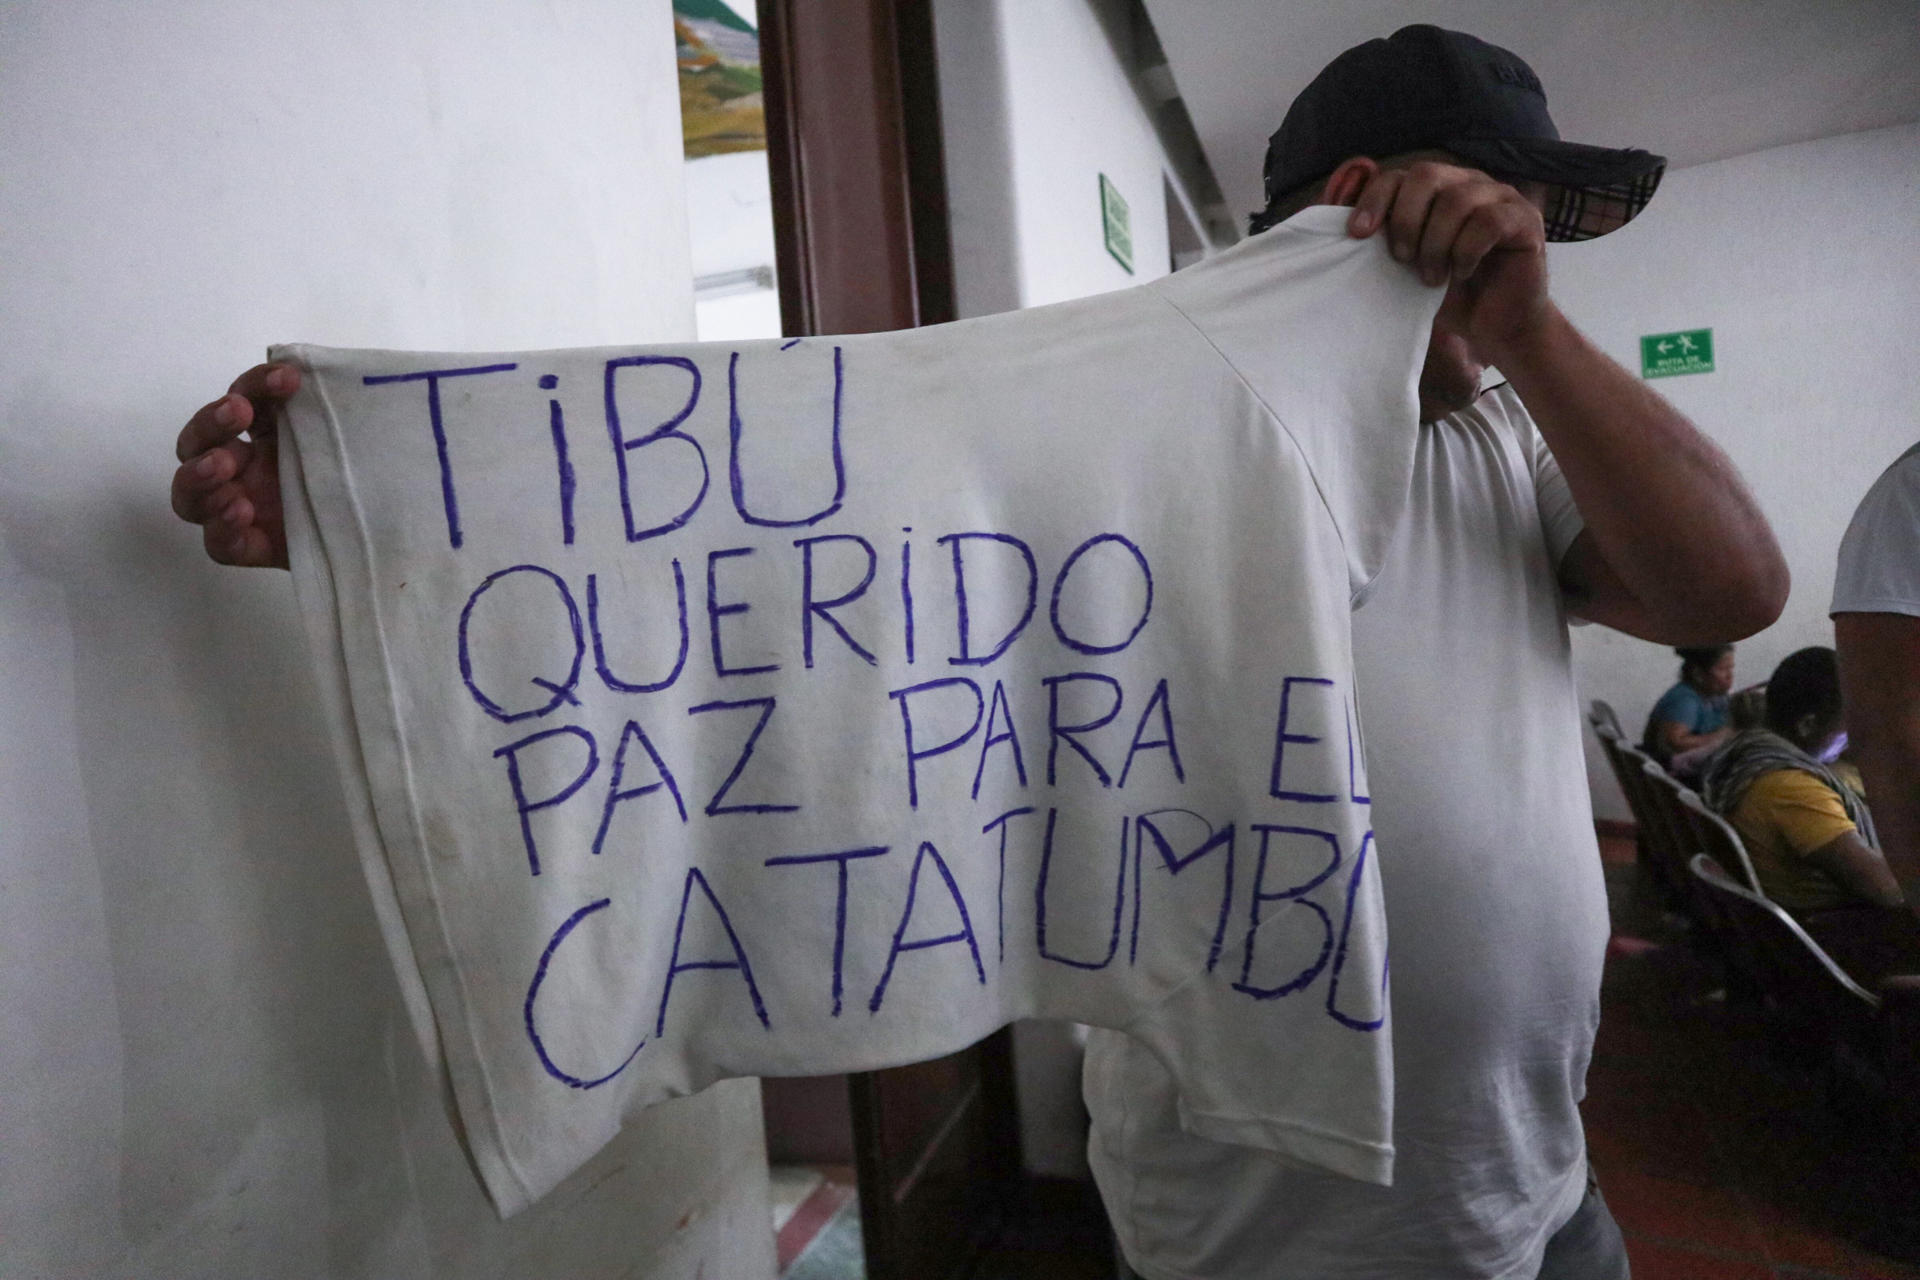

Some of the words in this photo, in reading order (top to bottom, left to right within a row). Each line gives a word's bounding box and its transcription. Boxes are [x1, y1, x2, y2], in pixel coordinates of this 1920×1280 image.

[493, 696, 801, 876] PAZ
[889, 672, 1185, 809] PARA
[1270, 676, 1372, 804] EL
